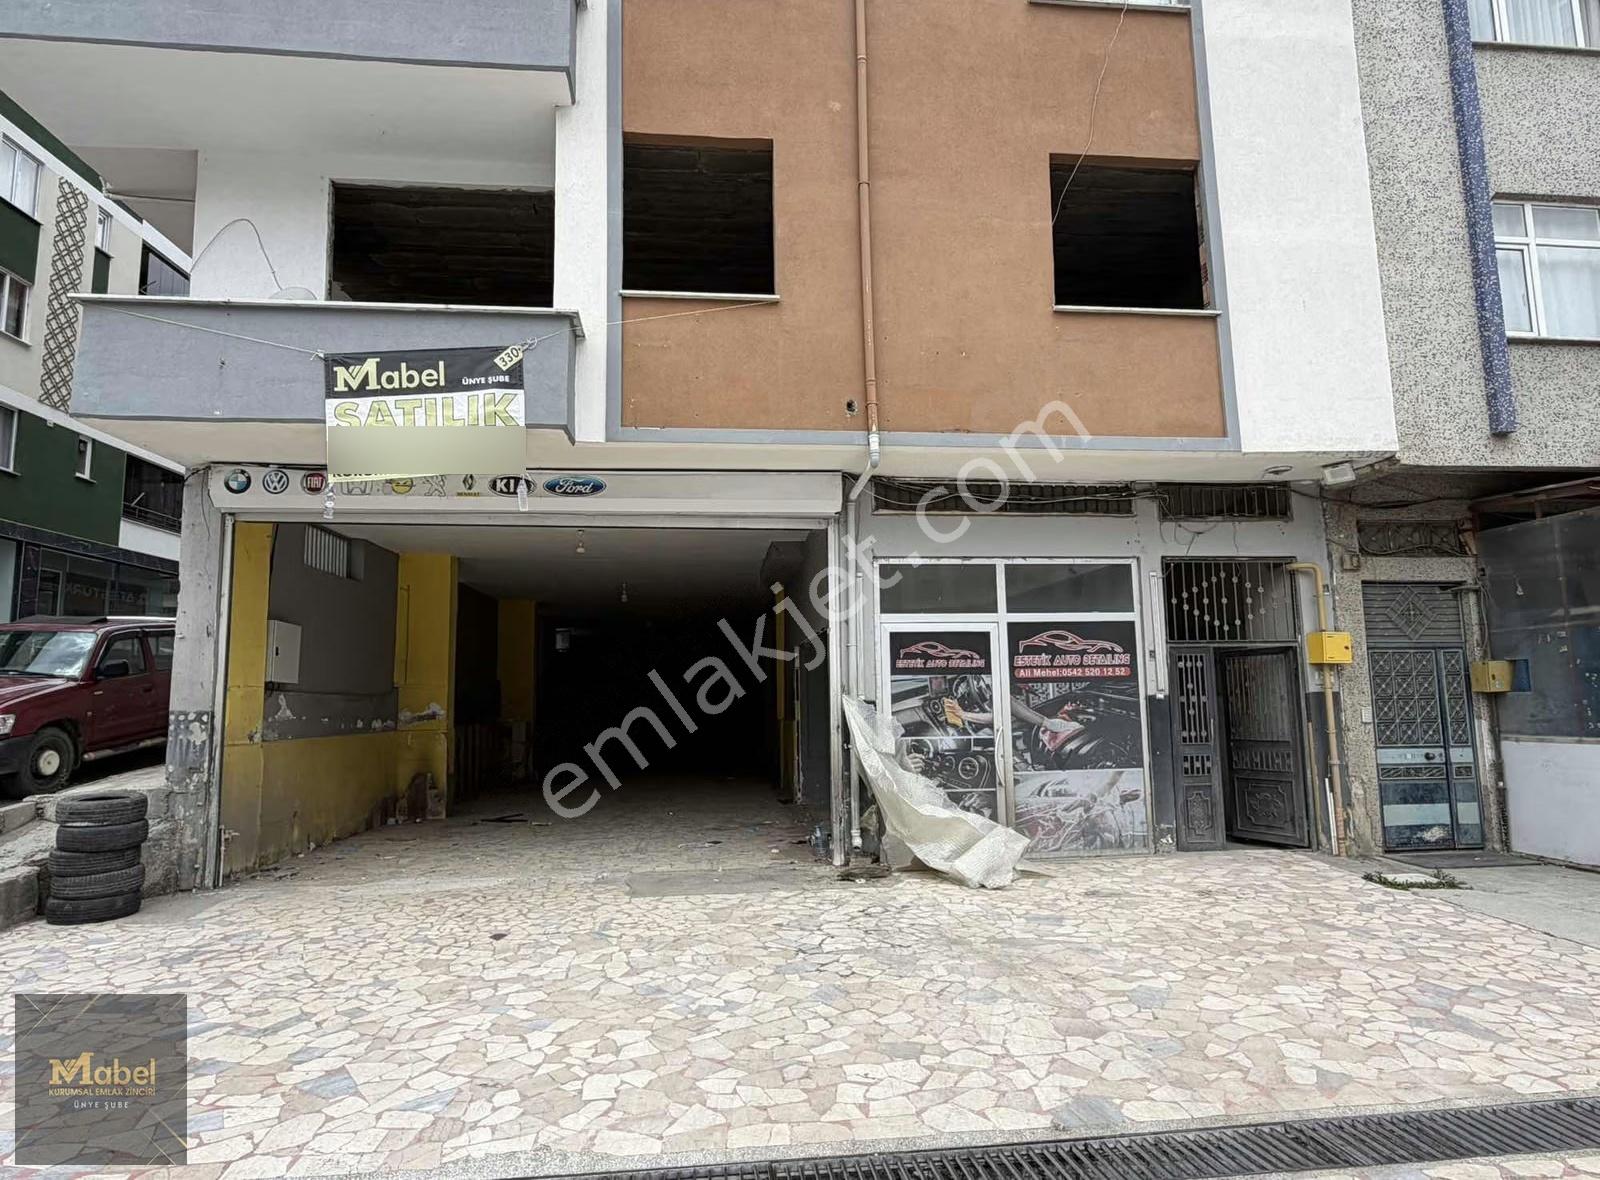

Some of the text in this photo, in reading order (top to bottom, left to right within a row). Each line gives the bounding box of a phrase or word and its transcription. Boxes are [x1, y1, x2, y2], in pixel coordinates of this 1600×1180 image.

[333, 357, 446, 392] Mabel
[461, 374, 510, 386] ÜNYE ŞUBE
[334, 392, 520, 427] SATILIK
[307, 476, 325, 490] FIAT
[555, 477, 595, 493] Ford
[1053, 653, 1081, 667] AUTO
[1085, 667, 1101, 677] 520
[1103, 667, 1114, 677] 12
[1115, 667, 1126, 676] 52
